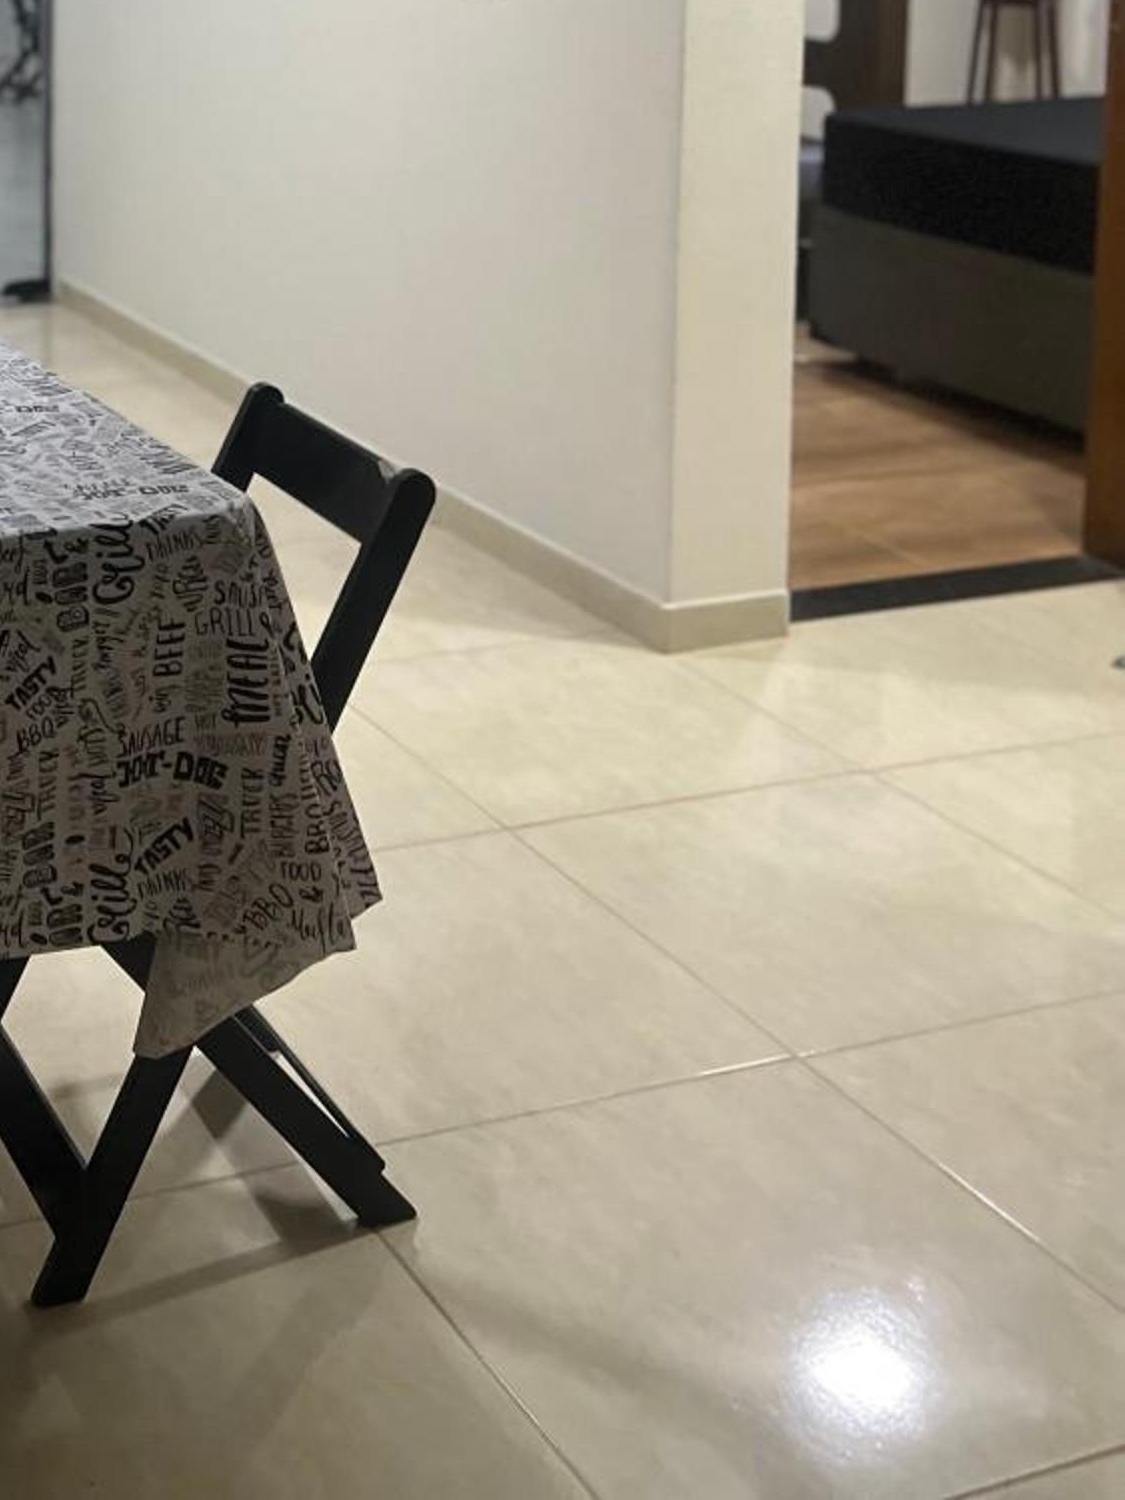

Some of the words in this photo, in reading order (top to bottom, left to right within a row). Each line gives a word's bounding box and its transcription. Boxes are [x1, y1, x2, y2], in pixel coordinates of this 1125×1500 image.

[152, 616, 186, 677] BEEF
[5, 655, 56, 710] TASTY
[220, 639, 271, 728] MEAL
[134, 817, 195, 875] TASTY
